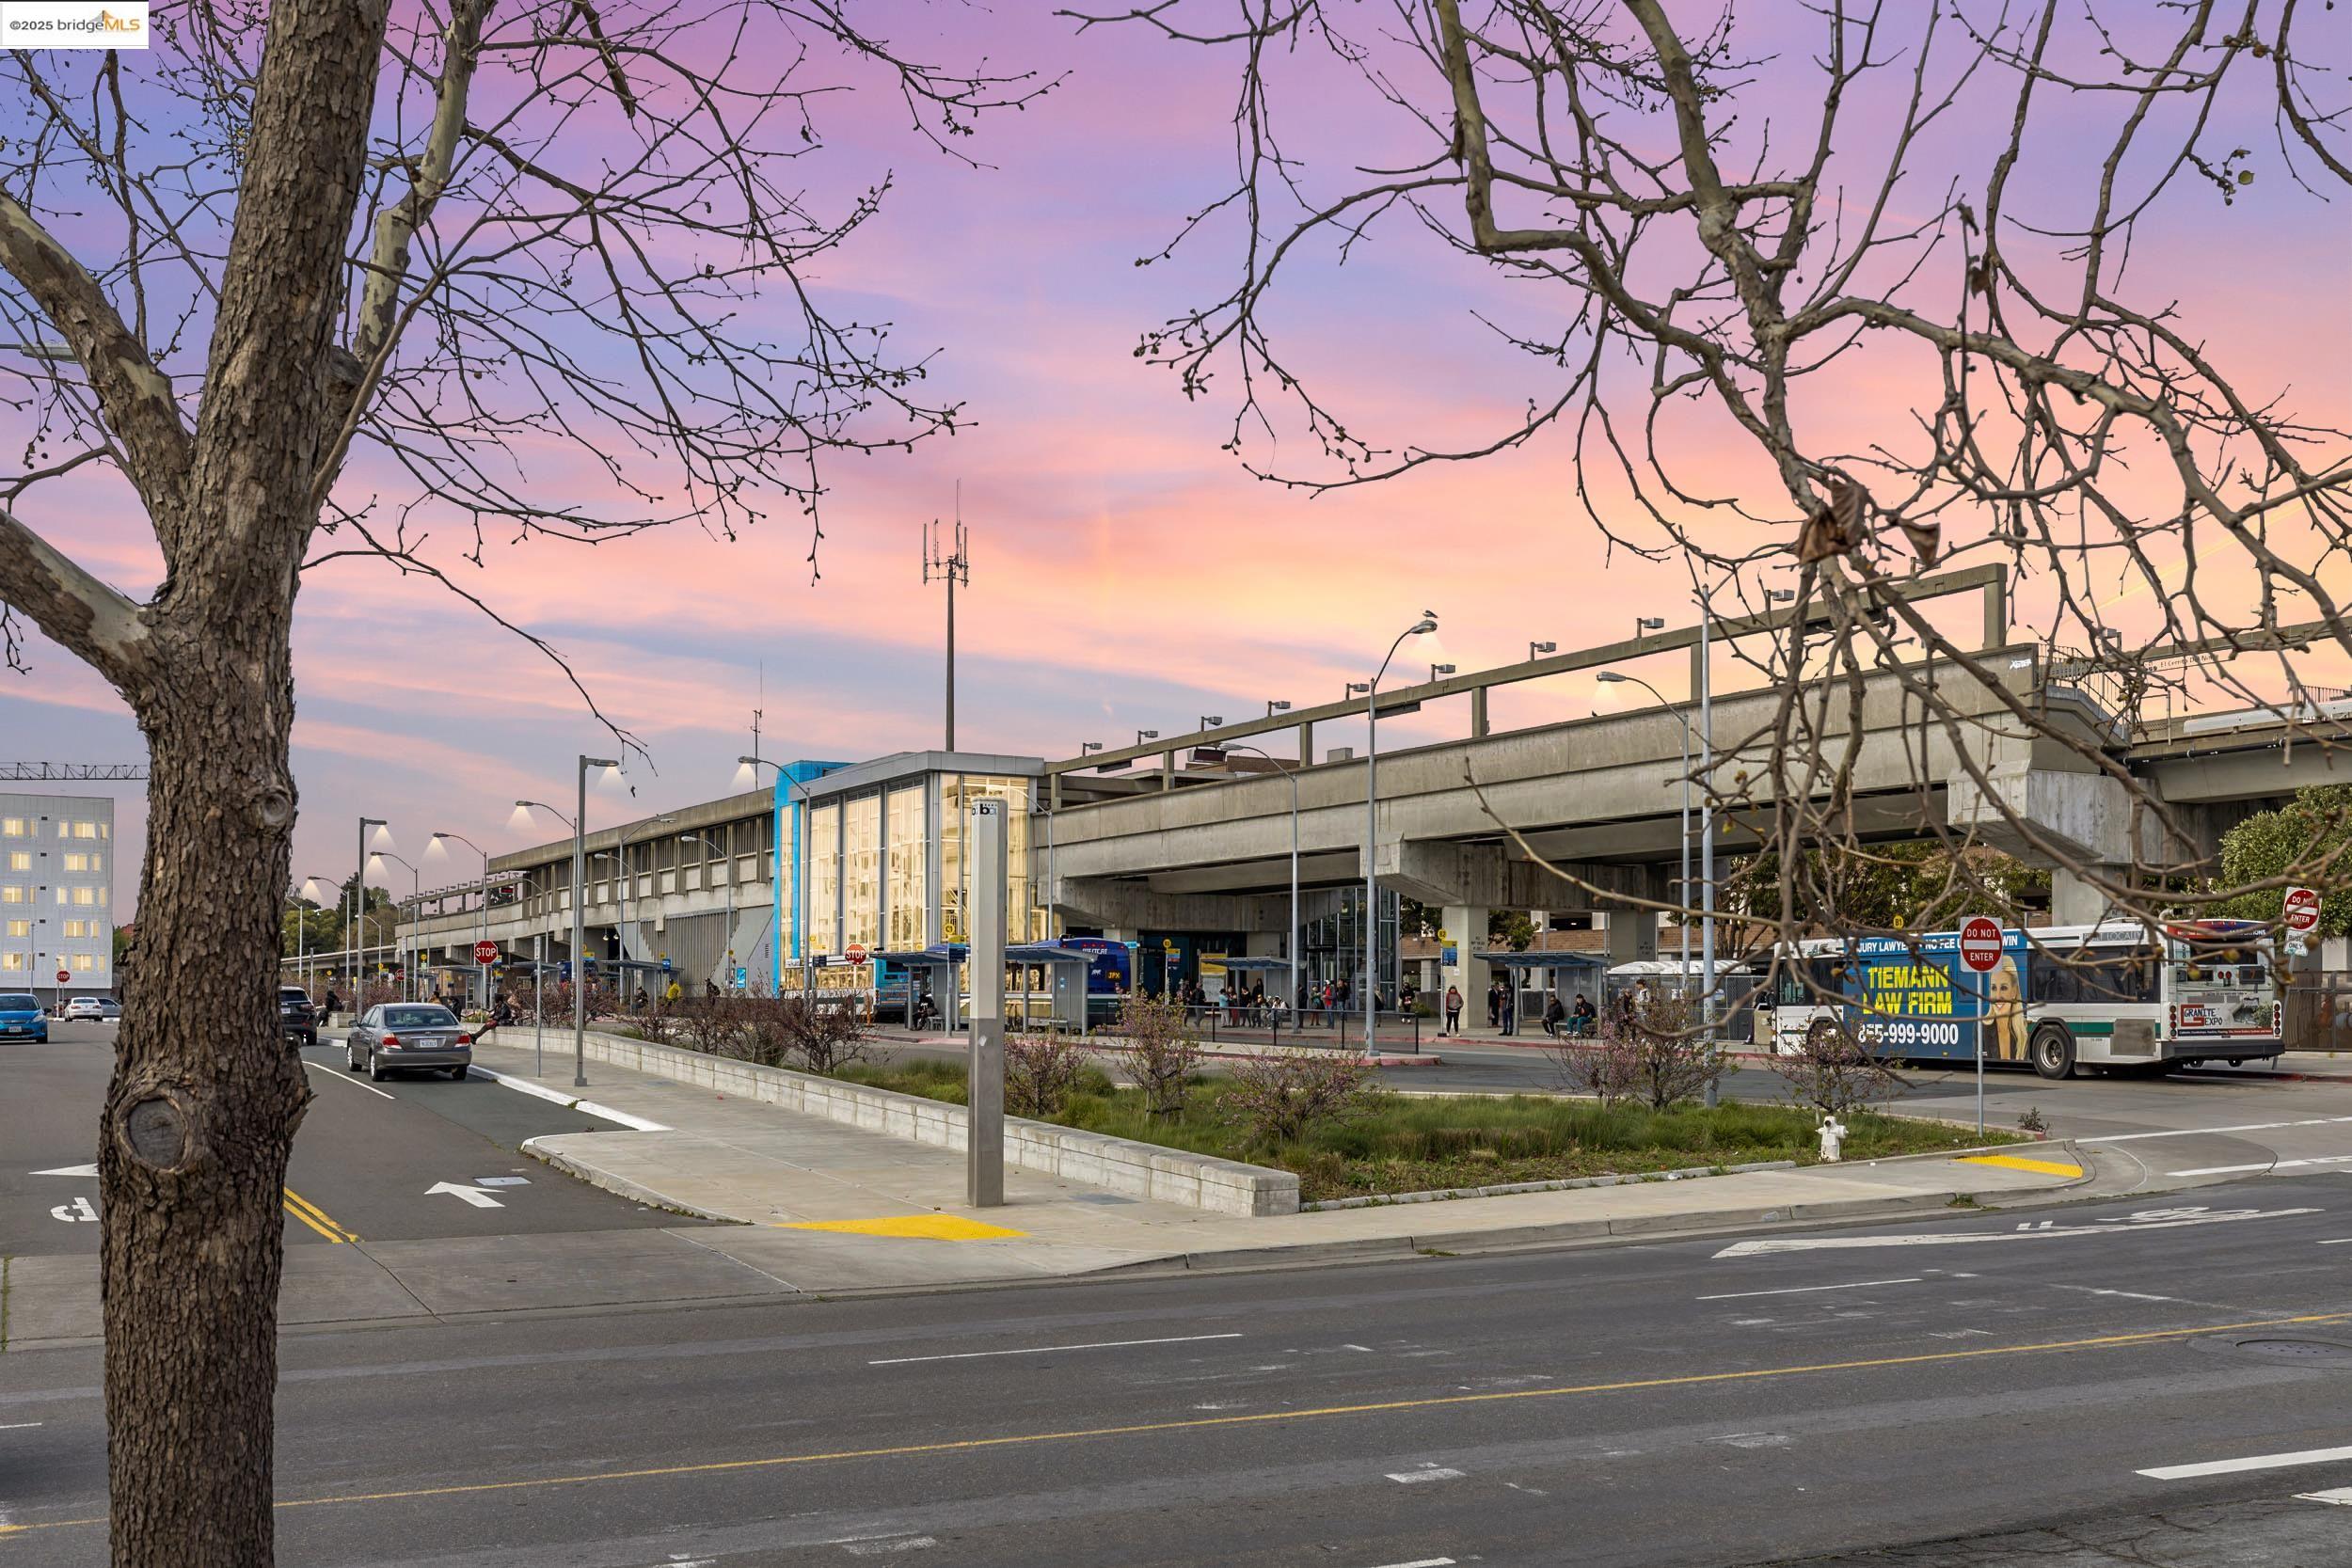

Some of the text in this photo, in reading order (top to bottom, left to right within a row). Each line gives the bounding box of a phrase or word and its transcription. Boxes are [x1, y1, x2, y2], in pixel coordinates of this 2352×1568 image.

[2292, 895, 2301, 904] DO
[2291, 913, 2311, 924] ENTER
[1966, 928, 1996, 938] DO NOT
[1879, 941, 1911, 952] LAWYE
[475, 947, 497, 958] STOP
[846, 949, 866, 959] STOP
[1969, 952, 1994, 961] ENTER
[1863, 991, 1952, 1014] LAW FIRM
[2184, 1008, 2216, 1018] GRANITE
[2204, 1017, 2223, 1025] EXPO
